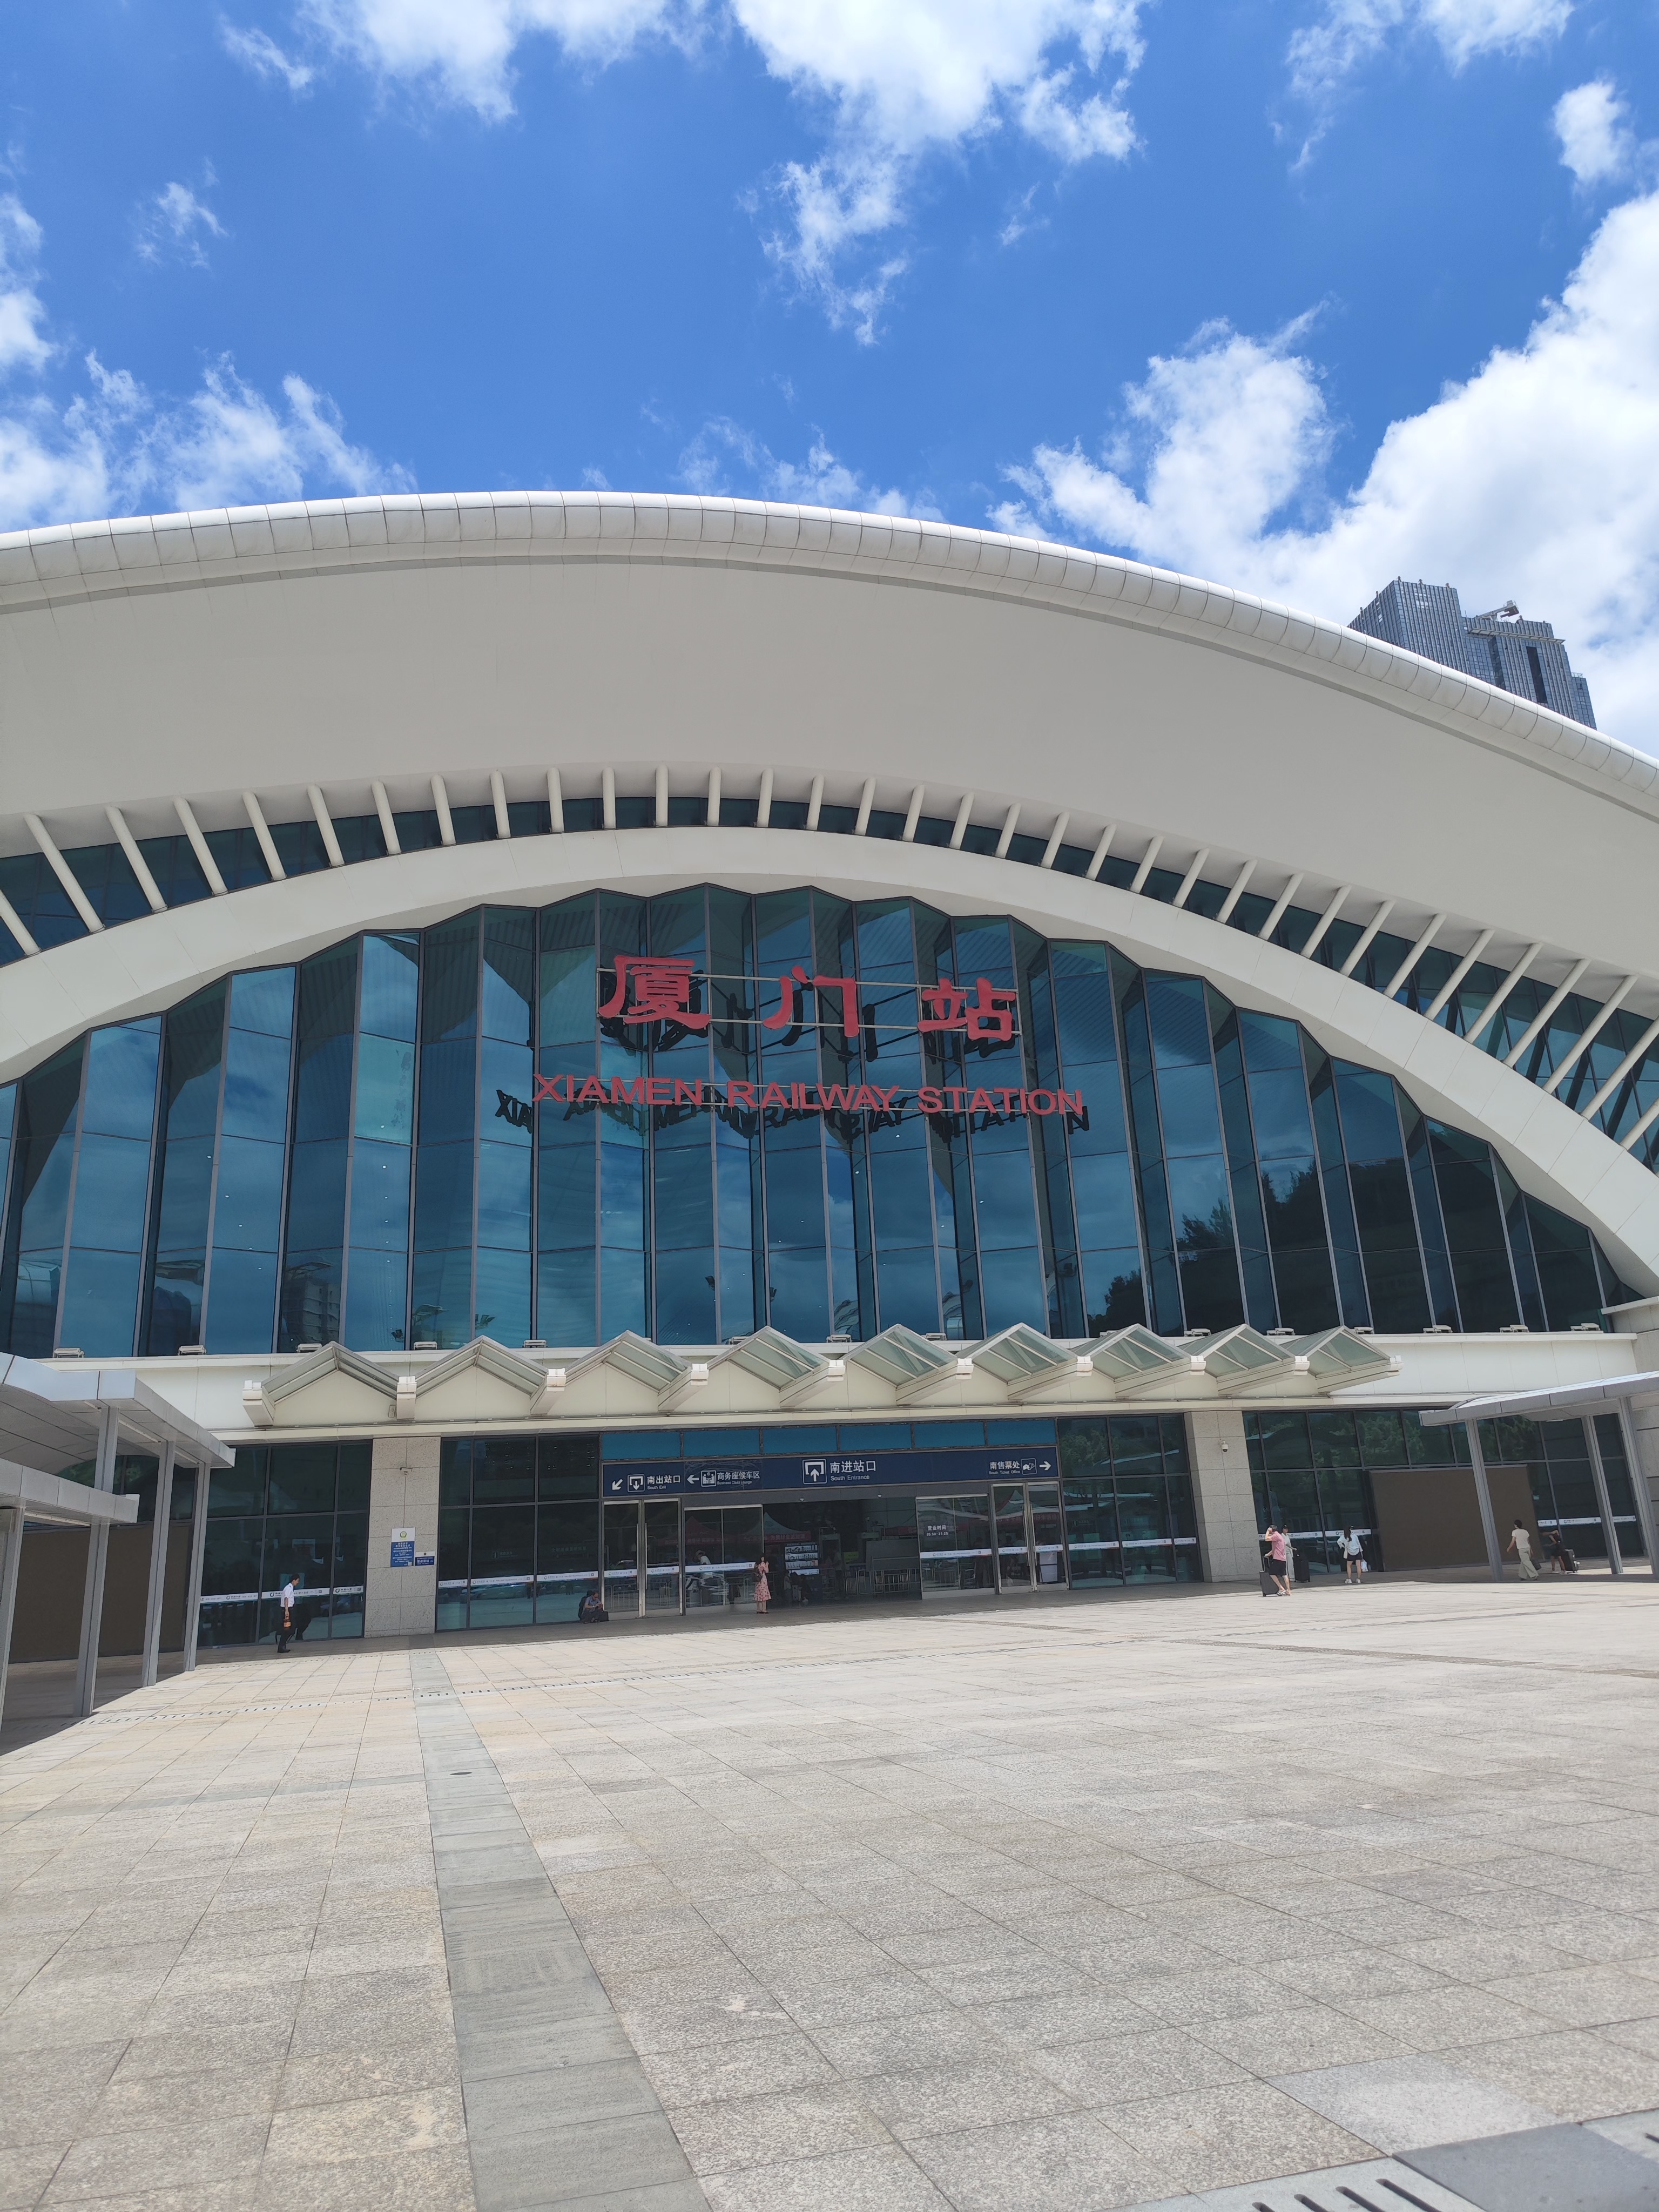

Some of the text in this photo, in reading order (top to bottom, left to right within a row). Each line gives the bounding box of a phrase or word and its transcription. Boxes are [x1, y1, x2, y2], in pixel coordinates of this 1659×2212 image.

[598, 954, 1016, 1041] 厦门站
[532, 1074, 1083, 1115] XIAMEN RAILWAY STATION
[830, 1459, 876, 1474] 南进站口
[989, 1460, 1020, 1470] 南售票处
[647, 1474, 680, 1485] 南出站口
[717, 1471, 760, 1480] 商务座候车区
